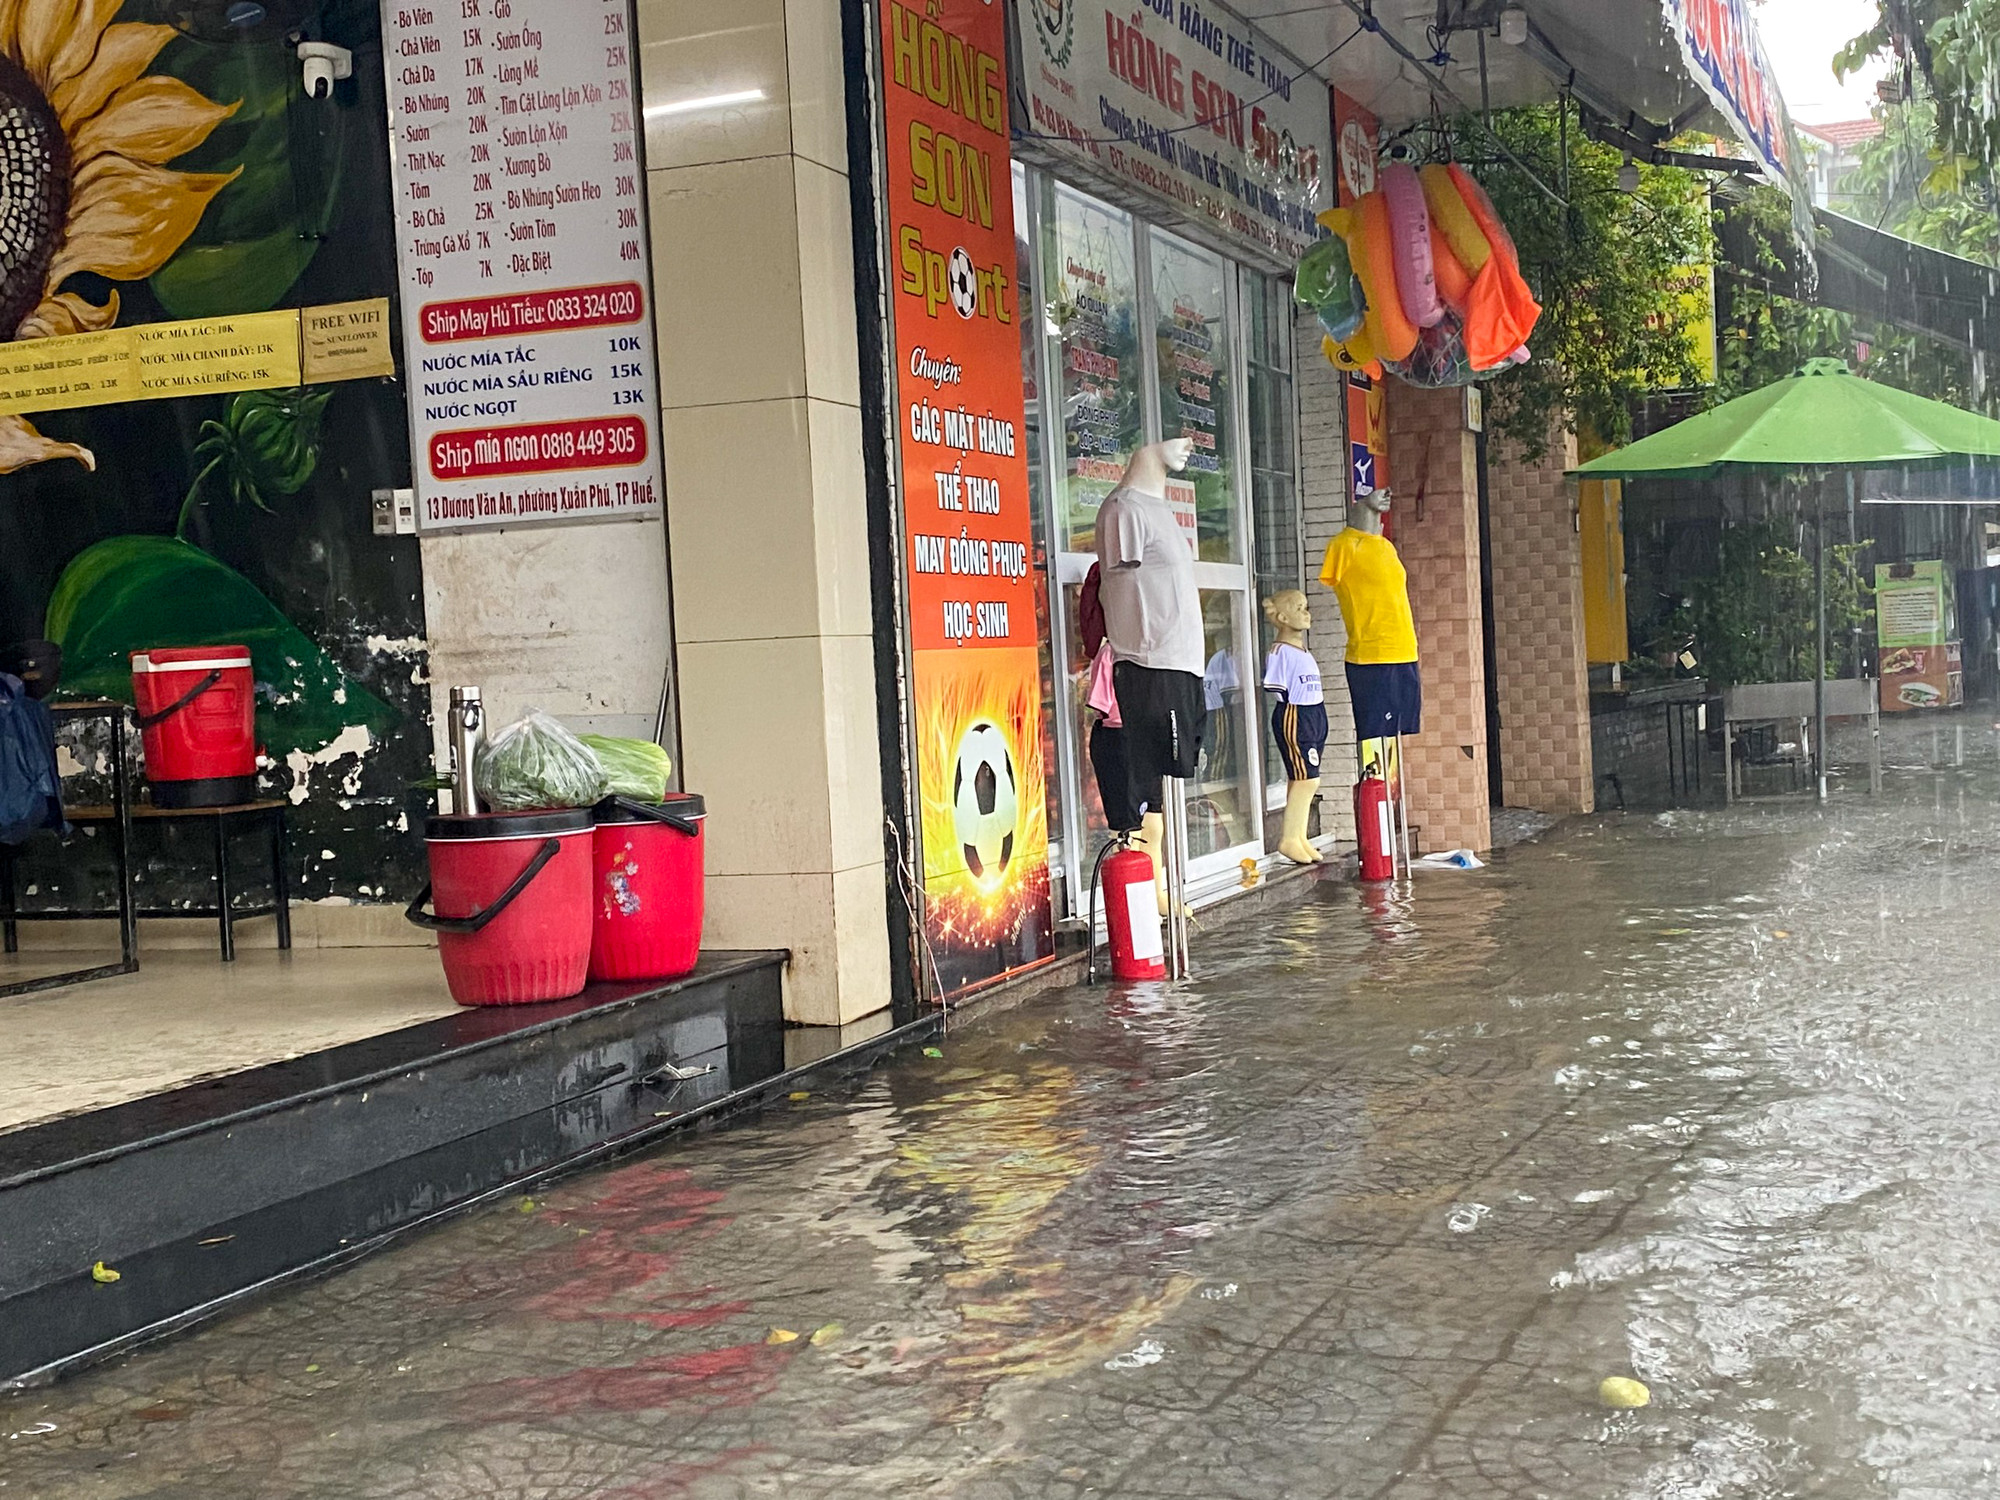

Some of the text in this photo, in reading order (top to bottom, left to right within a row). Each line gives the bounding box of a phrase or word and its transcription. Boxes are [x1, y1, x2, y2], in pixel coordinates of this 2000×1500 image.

[399, 0, 480, 28] Bò Viên 15K
[401, 29, 482, 56] Chả Viên 15K
[497, 14, 624, 50] Sườn Ống 25K
[499, 63, 521, 85] Lòng
[606, 46, 626, 67] 25K
[1180, 2, 1222, 58] HÀNG
[1260, 56, 1291, 102] THAO
[403, 58, 484, 85] Chả Da 17K
[1105, 9, 1186, 120] HỒNG
[1192, 69, 1245, 153] SƠN
[404, 87, 486, 114] Bò Nhúng 20K
[501, 79, 628, 116] Tim Cật Lòng Lộn Xộn 25K
[407, 116, 488, 142] Sườn 20K
[503, 112, 632, 148] Sườn Lộn Xộn 25K
[408, 144, 490, 174] Thịt Nạc 20K
[505, 143, 633, 178] Xương Bò 30K
[909, 120, 993, 230] SƠN
[410, 173, 492, 199] Tôm 20K
[508, 176, 635, 209] Bò Nhúng Sườn Heo 30K
[412, 202, 494, 228] Bò Chả 25K
[510, 209, 637, 241] Sườn Tôm 30K
[415, 238, 441, 258] Trứng
[443, 235, 455, 251] Gà
[477, 232, 490, 249] 7K
[512, 241, 640, 275] Đặc Biệt 40K
[416, 261, 492, 288] Tóp 7K
[218, 324, 234, 334] 10K
[312, 309, 381, 331] FREE WIFI
[428, 291, 634, 338] Ship May Hủ Tiếu: 0833 324 020
[194, 348, 228, 360] CHANH
[257, 344, 274, 354] 13K
[326, 330, 379, 345] SUNFLOWER
[422, 337, 641, 372] NƯỚC MÍA TẮC 10K
[910, 345, 962, 390] Chuyên:
[100, 379, 118, 388] 13K
[253, 369, 270, 379] 15K
[424, 377, 468, 396] NƯỚC
[473, 374, 503, 392] MÍA
[544, 367, 593, 385] RIÊNG
[610, 363, 643, 379] 15K
[426, 389, 644, 420] NƯỚC NGỌT 13K
[1469, 397, 1480, 425] 13
[910, 397, 1015, 458] CÁC MẶT HÀNG
[436, 442, 471, 474] Ship
[542, 432, 574, 459] 0818
[577, 429, 604, 456] 449
[608, 427, 635, 454] 305
[427, 476, 657, 520] 13 Dương Văn An, phường Xuân Phú, TP Huế.
[934, 460, 1000, 515] THỂ THAO
[914, 526, 1027, 584] MAY ĐỒNG PHỤC
[943, 600, 1009, 646] HỌC SINH
